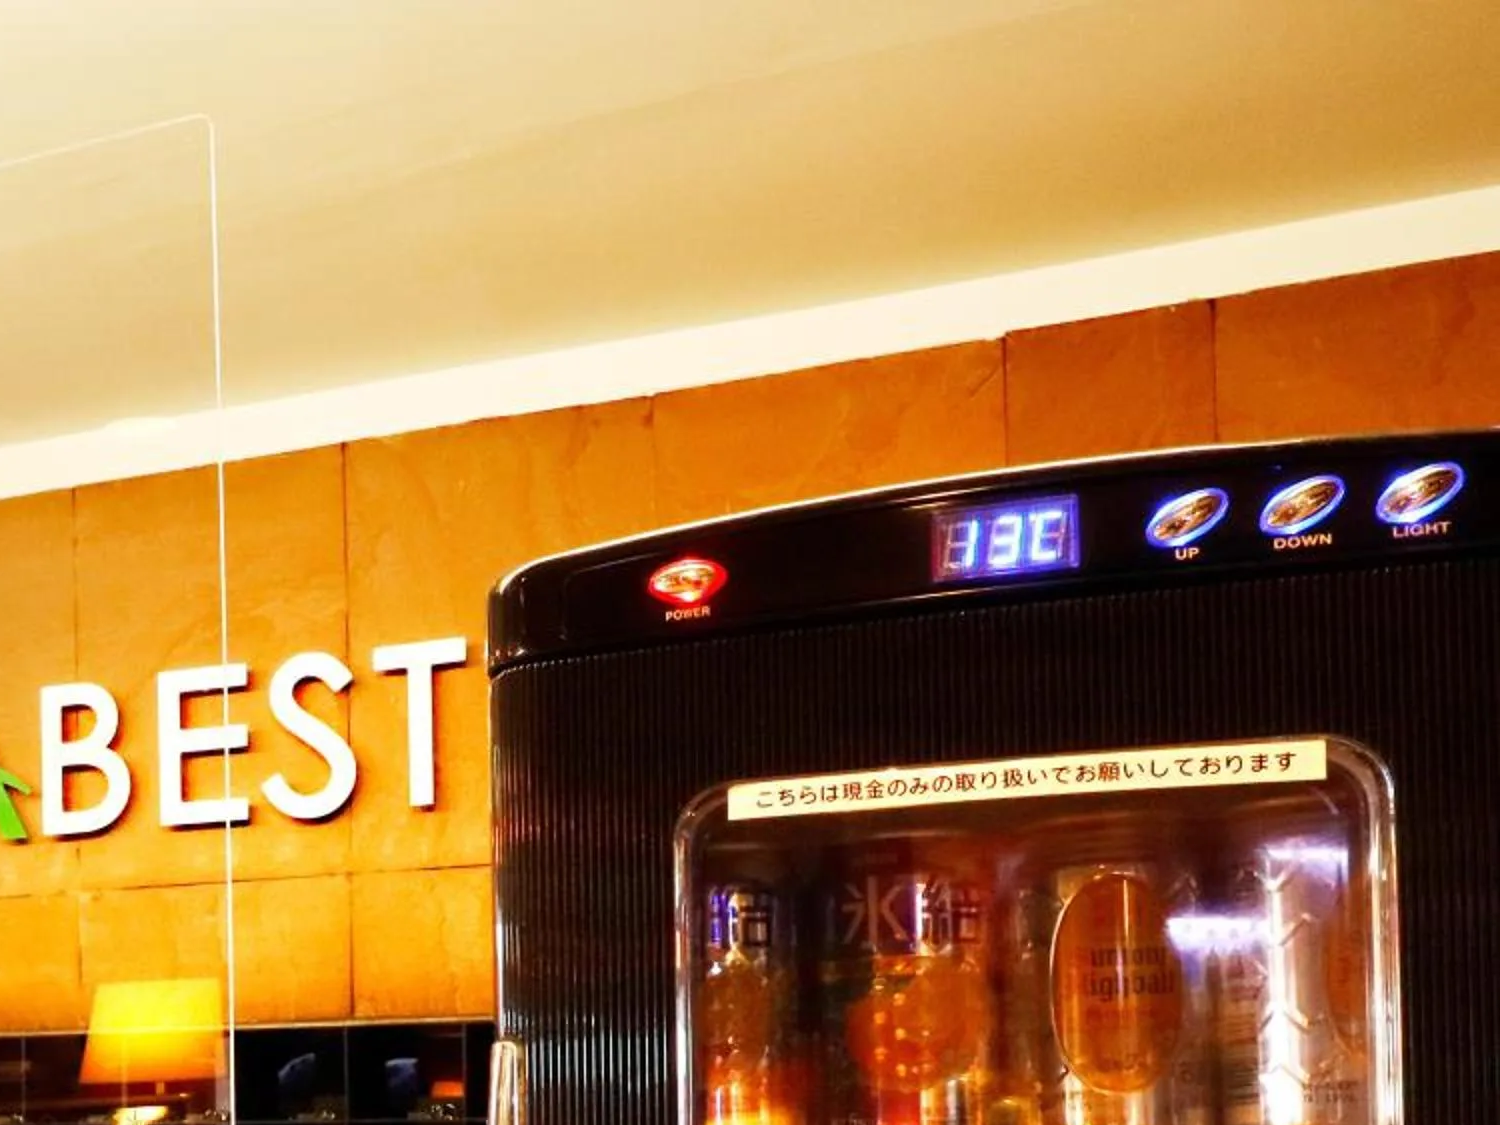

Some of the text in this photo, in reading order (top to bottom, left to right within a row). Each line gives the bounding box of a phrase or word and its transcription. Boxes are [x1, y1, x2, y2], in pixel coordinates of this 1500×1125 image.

[1392, 521, 1451, 540] LIGHT
[1273, 532, 1333, 550] DOWN
[1174, 547, 1200, 561] UP
[665, 605, 711, 622] POWER
[756, 751, 1297, 809] こちらは現金のみの取り扱いでお願いしております
